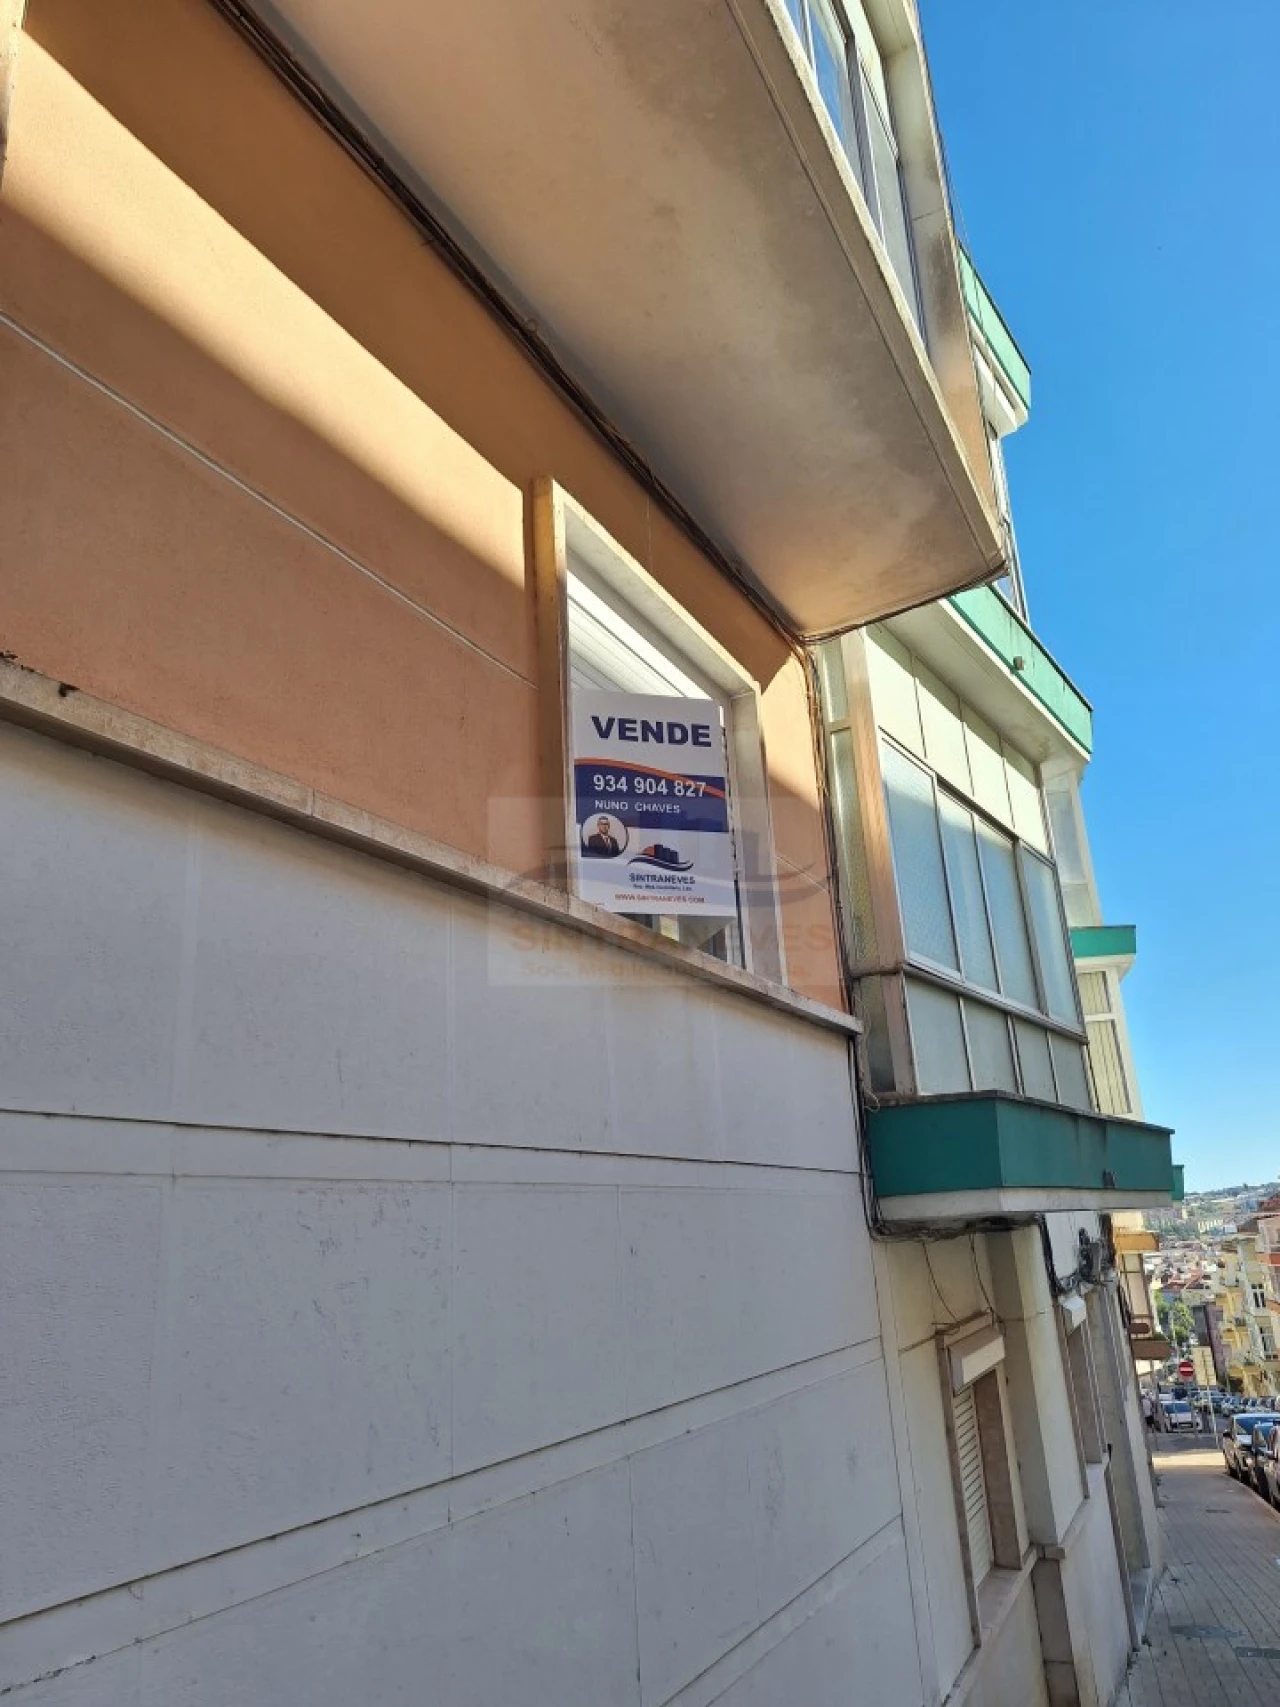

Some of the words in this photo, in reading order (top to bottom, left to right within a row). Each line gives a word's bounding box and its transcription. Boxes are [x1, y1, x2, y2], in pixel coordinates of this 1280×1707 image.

[591, 716, 712, 748] VENDE
[593, 774, 628, 792] 934
[634, 776, 668, 796] 904
[674, 780, 707, 798] 827
[595, 800, 628, 811] NUNO
[635, 802, 681, 814] CHAVES
[629, 872, 696, 885] SINTRANEVES
